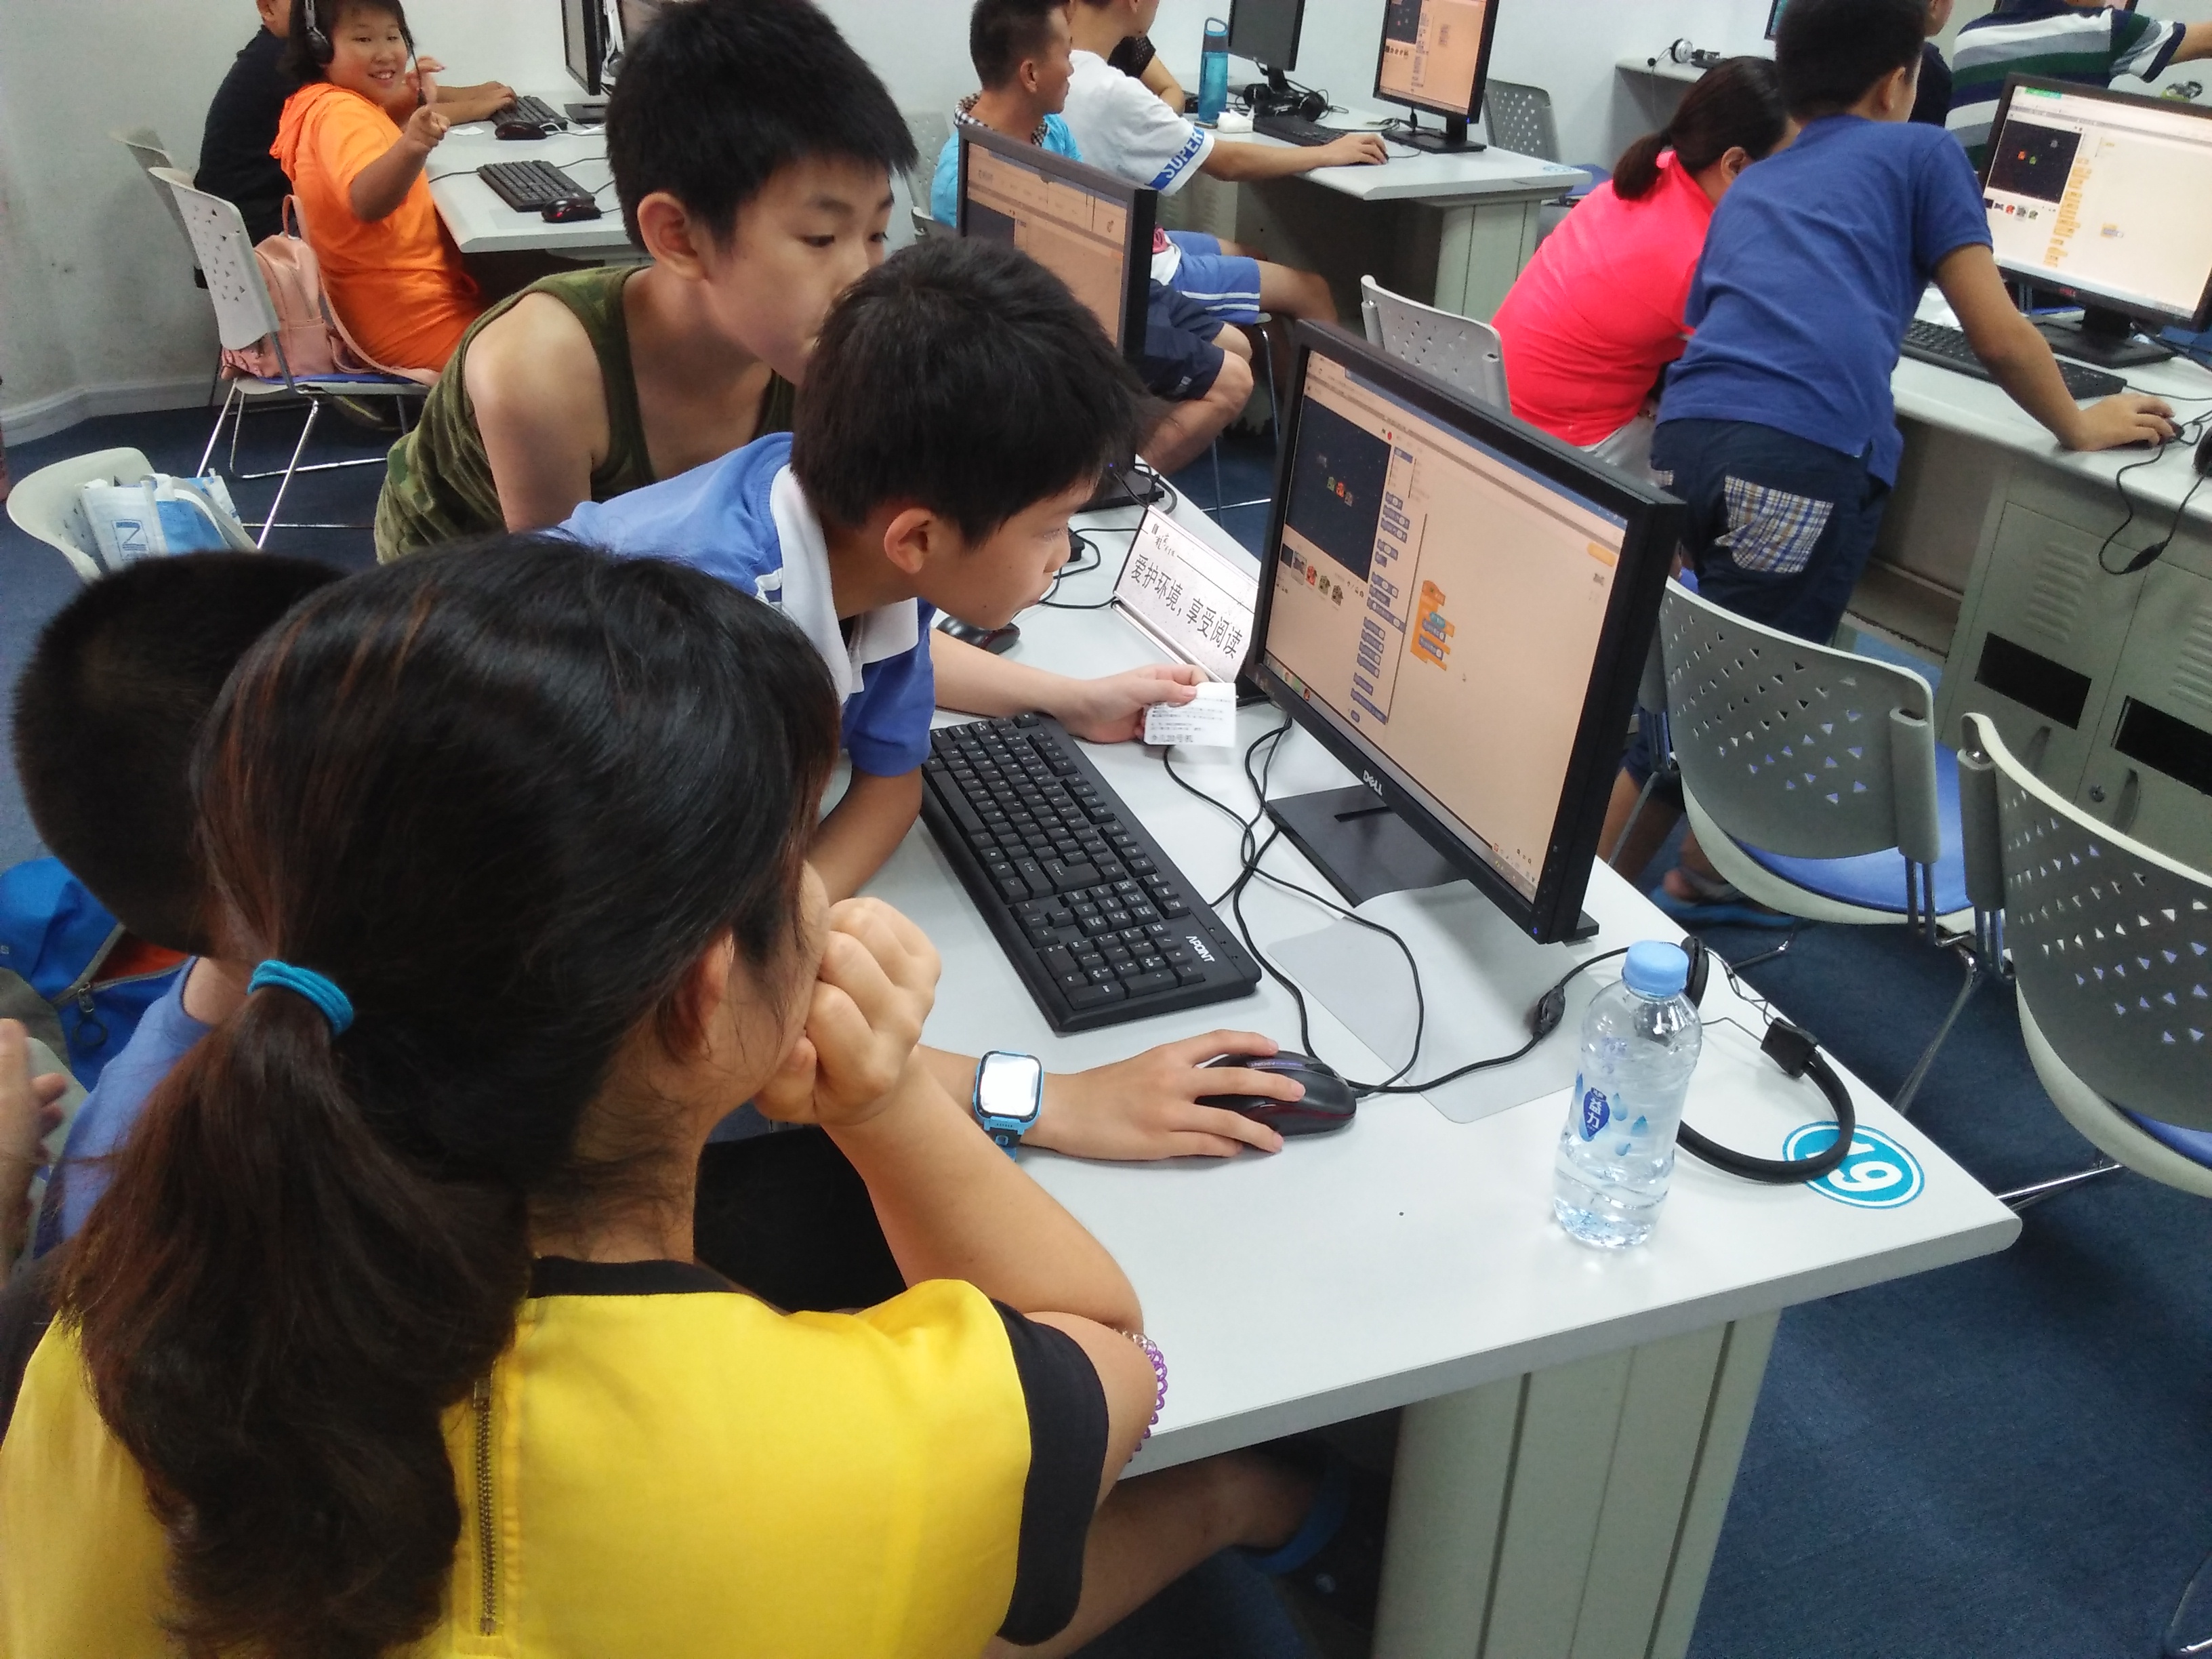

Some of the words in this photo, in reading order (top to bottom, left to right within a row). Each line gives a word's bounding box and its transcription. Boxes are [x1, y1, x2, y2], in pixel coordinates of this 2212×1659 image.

[1363, 769, 1382, 796] DELL
[1185, 936, 1215, 962] APOINT
[1586, 1097, 1602, 1129] 益力
